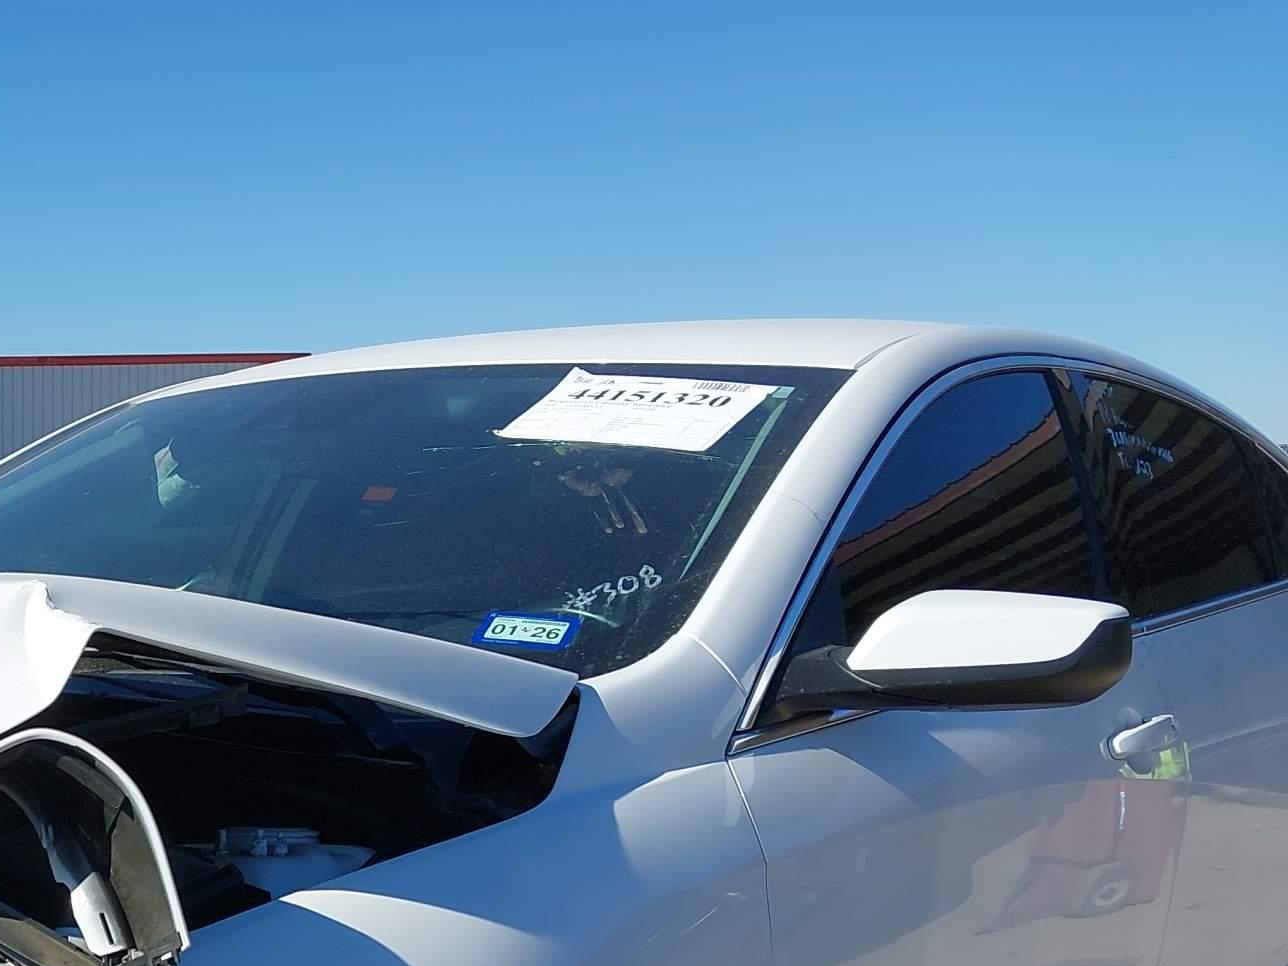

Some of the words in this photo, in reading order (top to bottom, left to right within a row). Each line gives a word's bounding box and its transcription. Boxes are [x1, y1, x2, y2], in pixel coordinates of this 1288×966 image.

[567, 388, 732, 408] 44151320
[561, 564, 662, 611] #308
[530, 626, 562, 640] 26
